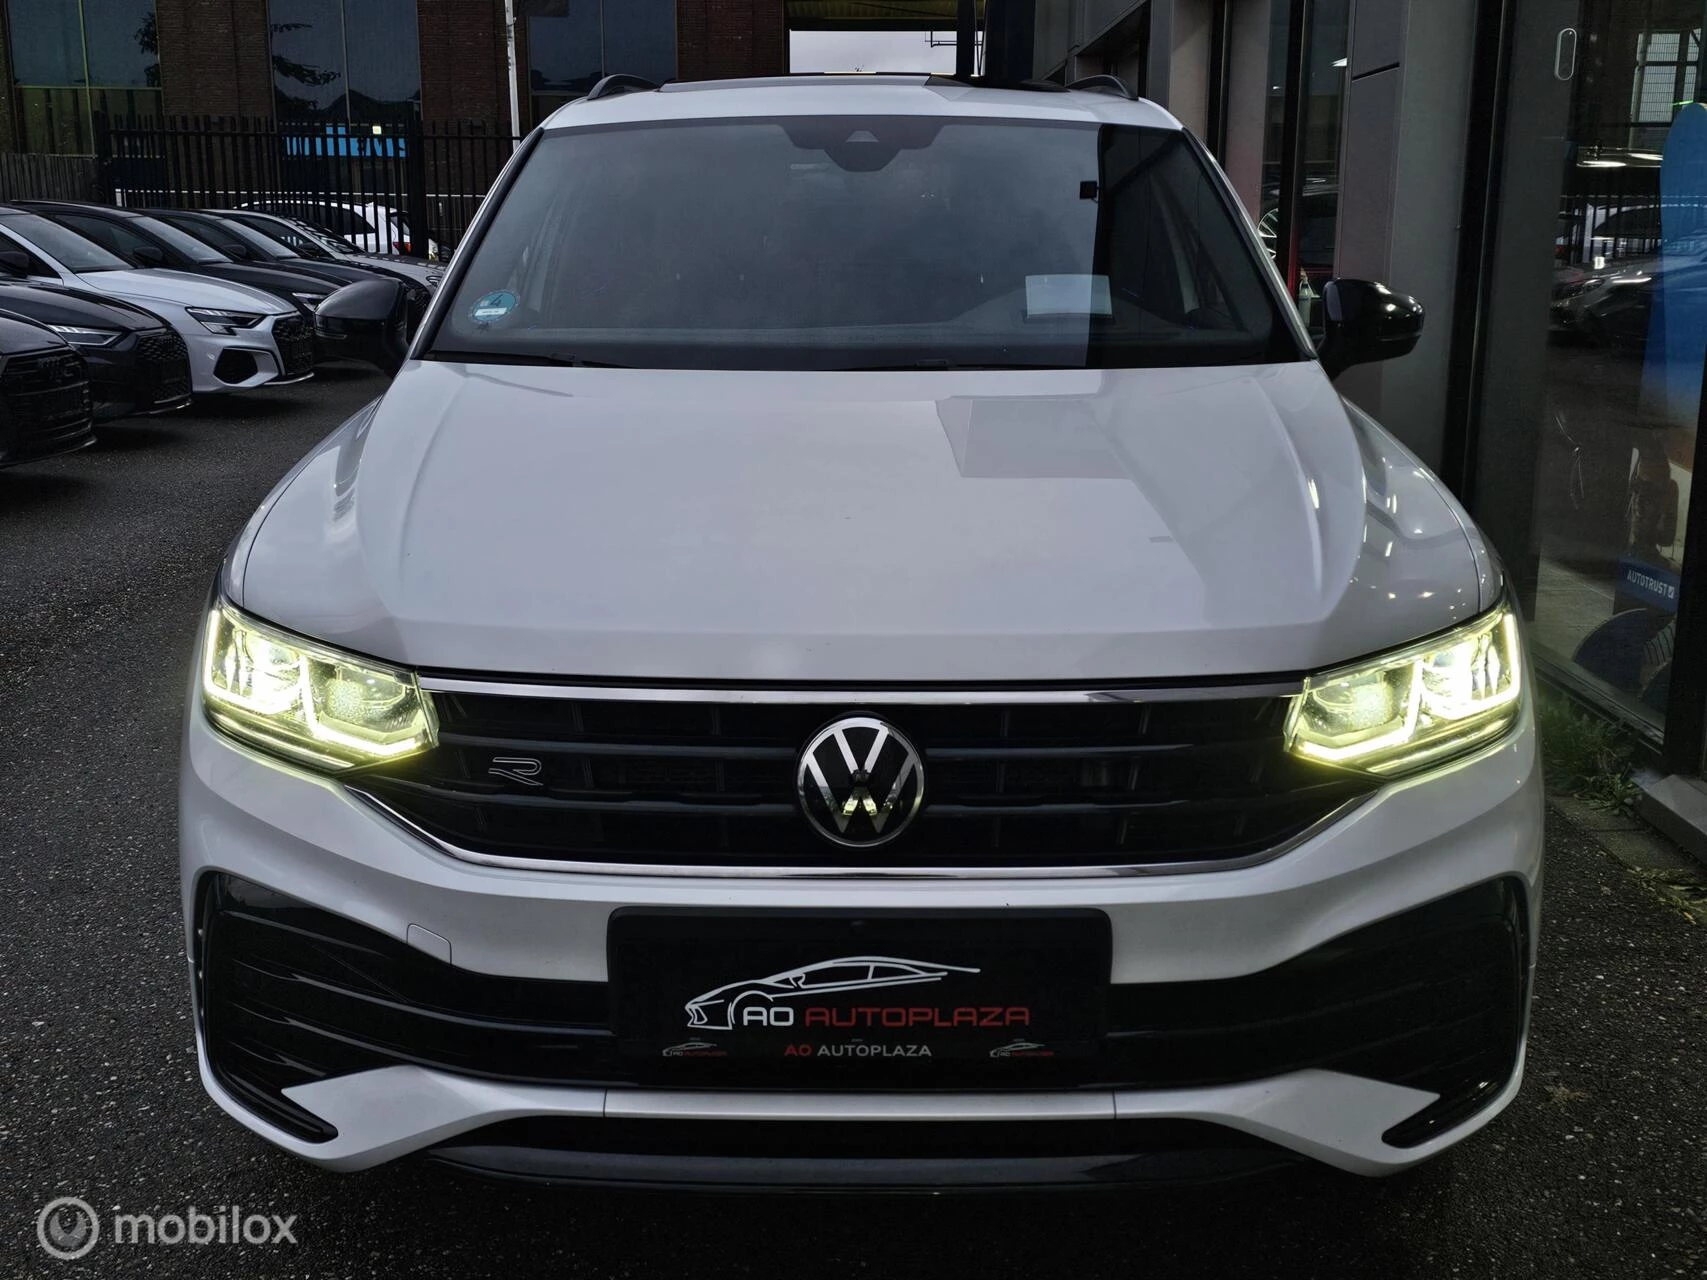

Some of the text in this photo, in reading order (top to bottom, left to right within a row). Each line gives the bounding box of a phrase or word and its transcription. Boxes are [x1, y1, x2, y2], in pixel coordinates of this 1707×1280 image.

[1627, 570, 1667, 596] AUTOTRUST
[488, 756, 543, 786] R
[742, 1006, 1030, 1027] AO AUTOPLAZA
[784, 1044, 932, 1058] AO AUTOPLAZA
